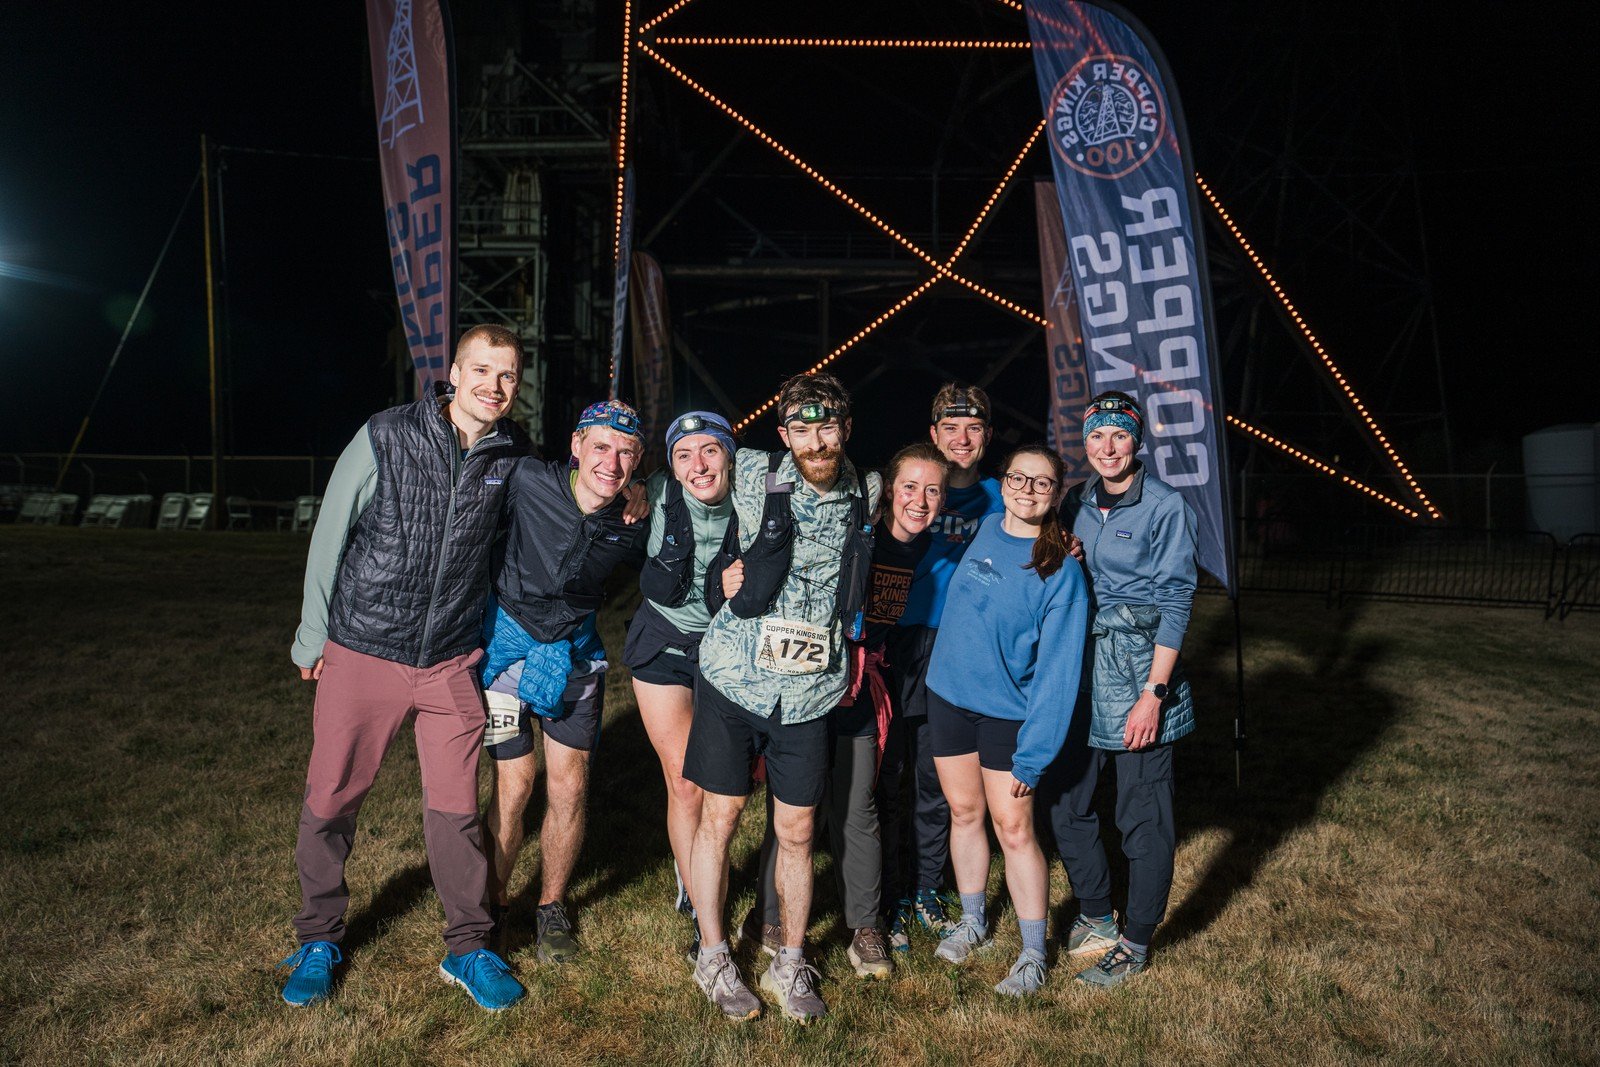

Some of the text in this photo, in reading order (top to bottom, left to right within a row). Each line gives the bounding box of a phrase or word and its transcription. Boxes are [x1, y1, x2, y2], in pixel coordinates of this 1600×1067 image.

[766, 624, 795, 635] COPPER
[796, 629, 816, 640] KINGS
[816, 633, 828, 641] 100
[780, 638, 824, 663] 172
